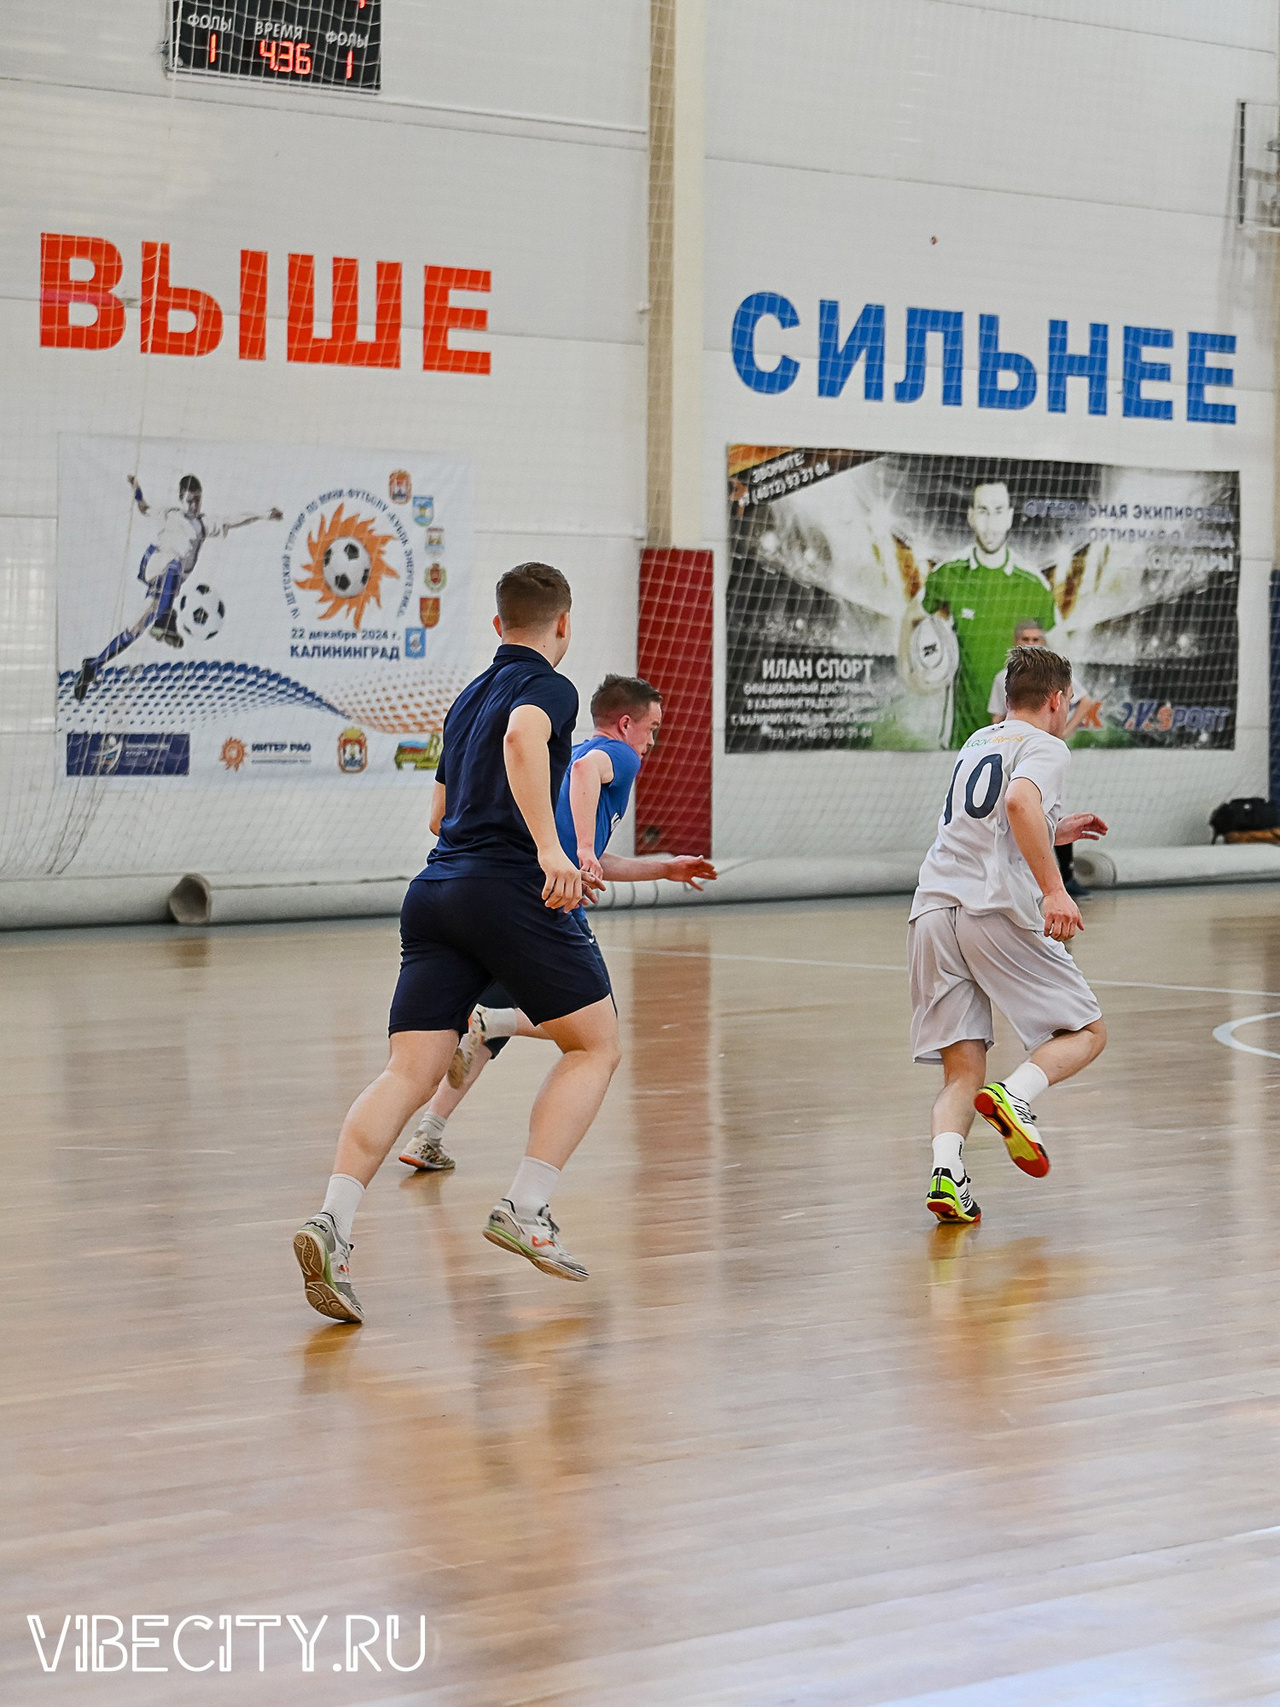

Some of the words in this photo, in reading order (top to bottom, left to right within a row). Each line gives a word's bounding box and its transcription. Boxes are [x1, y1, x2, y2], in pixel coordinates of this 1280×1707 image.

[187, 13, 233, 34] ФОЛЫ
[254, 21, 304, 40] ВРЕМЯ
[39, 232, 492, 376] ВЫШЕ
[731, 291, 1237, 425] СИЛЬНЕЕ
[291, 628, 305, 640] 22
[290, 645, 400, 661] КАЛИНИНГРАД
[761, 657, 813, 680] ИЛАН
[815, 658, 874, 681] СПОРТ
[943, 753, 1003, 826] 10
